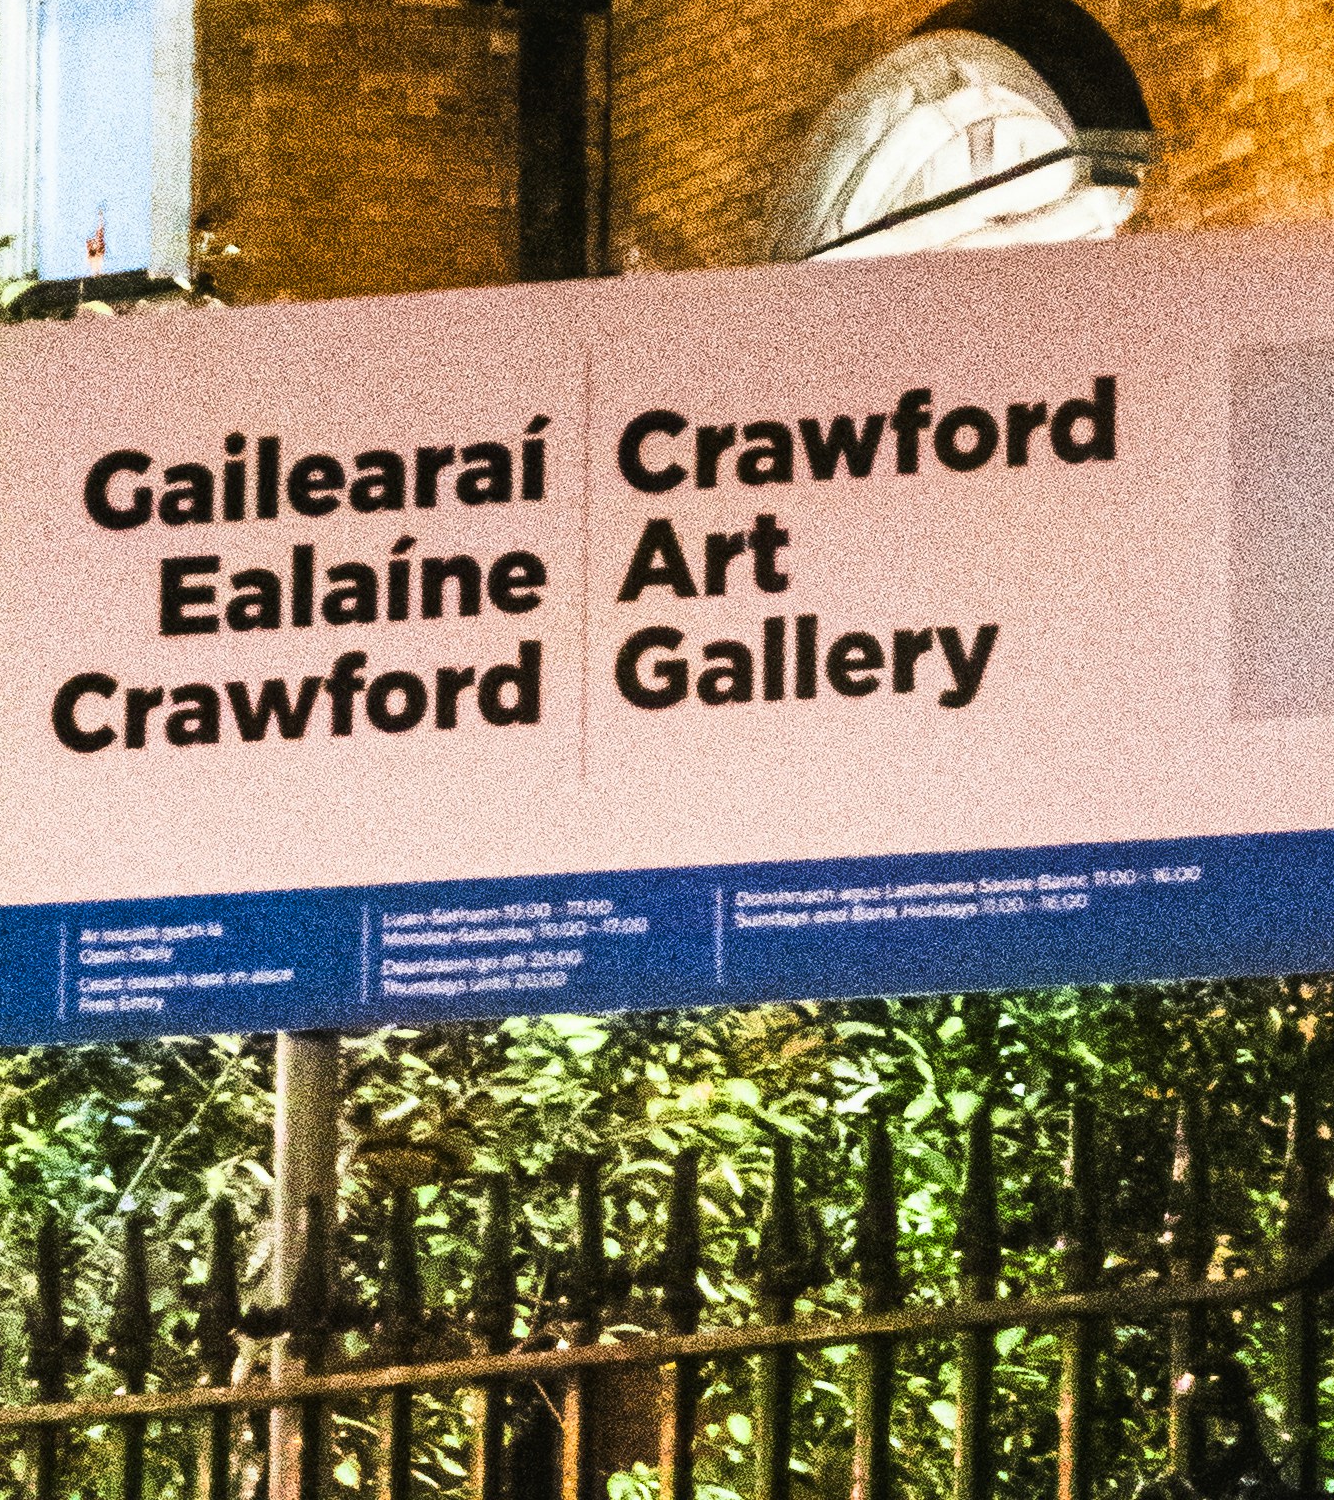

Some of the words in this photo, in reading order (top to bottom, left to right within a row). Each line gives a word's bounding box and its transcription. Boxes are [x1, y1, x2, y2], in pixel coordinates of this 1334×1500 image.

[84, 416, 549, 530] Gailearaí
[618, 376, 1116, 494] Crawford
[160, 537, 546, 636] Ealaíne
[619, 515, 788, 601] Art
[53, 641, 541, 752] Crawford
[616, 616, 997, 709] Gallery
[814, 907, 846, 922] and
[119, 995, 164, 1012] Entry
